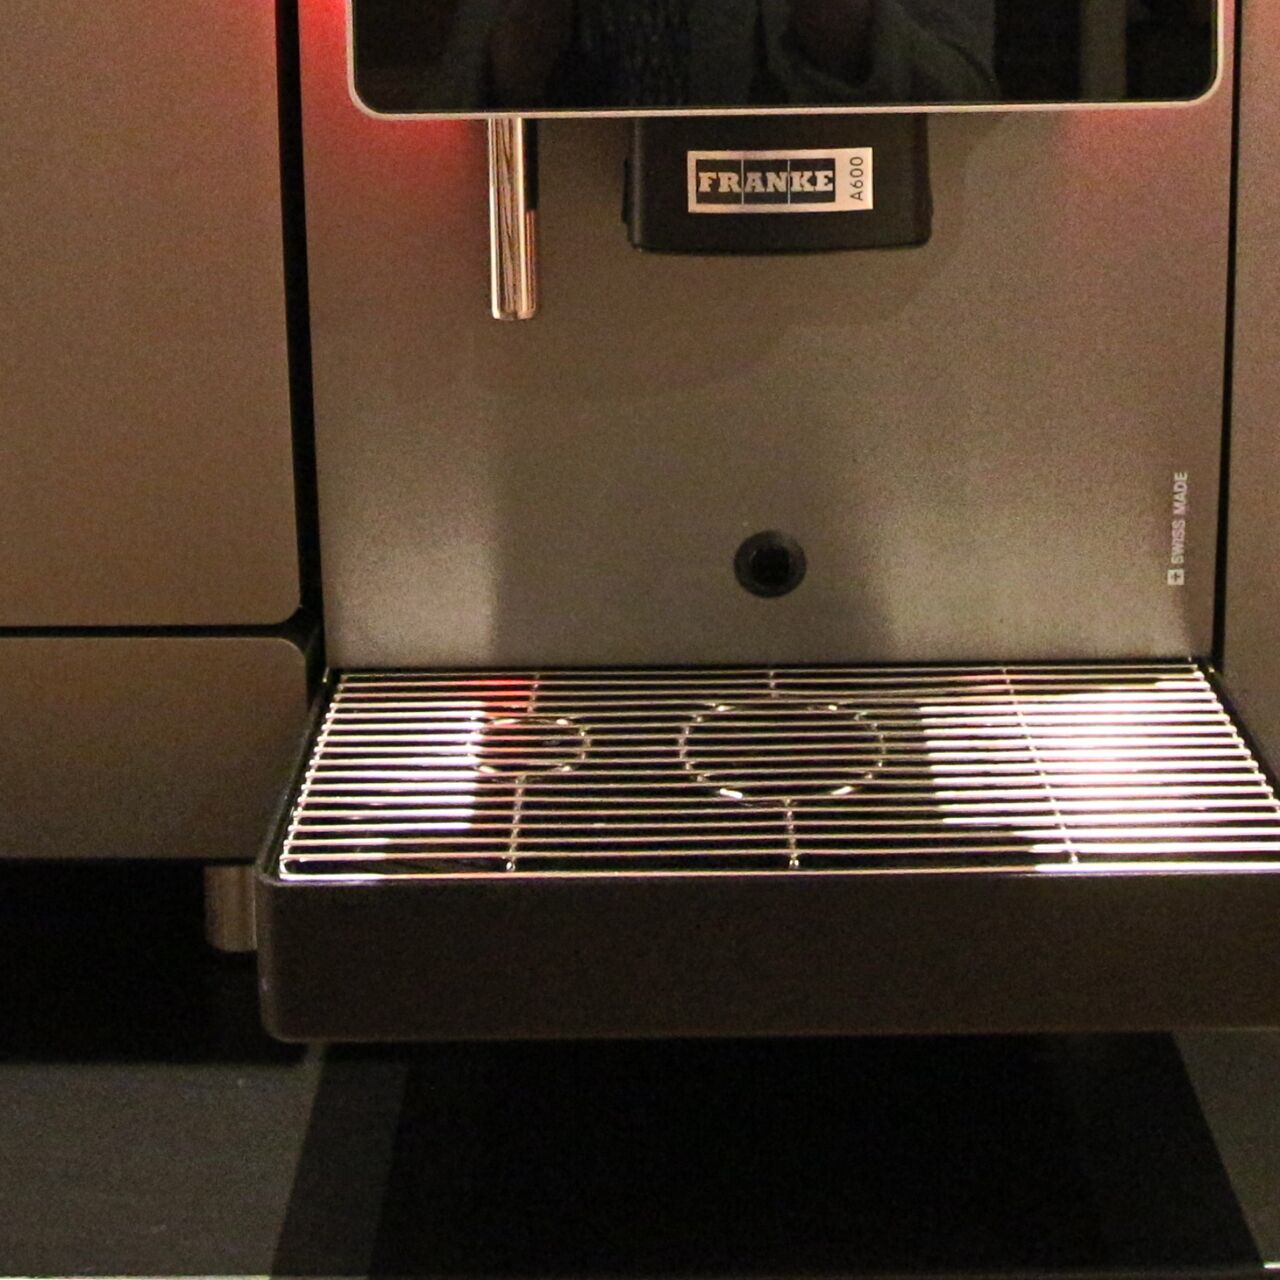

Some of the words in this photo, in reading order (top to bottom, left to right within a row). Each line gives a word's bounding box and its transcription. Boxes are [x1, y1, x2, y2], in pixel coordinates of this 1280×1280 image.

[697, 170, 834, 193] FRANKE
[849, 156, 864, 202] A600
[1173, 471, 1188, 515] MADE
[1170, 519, 1186, 565] SWISS
